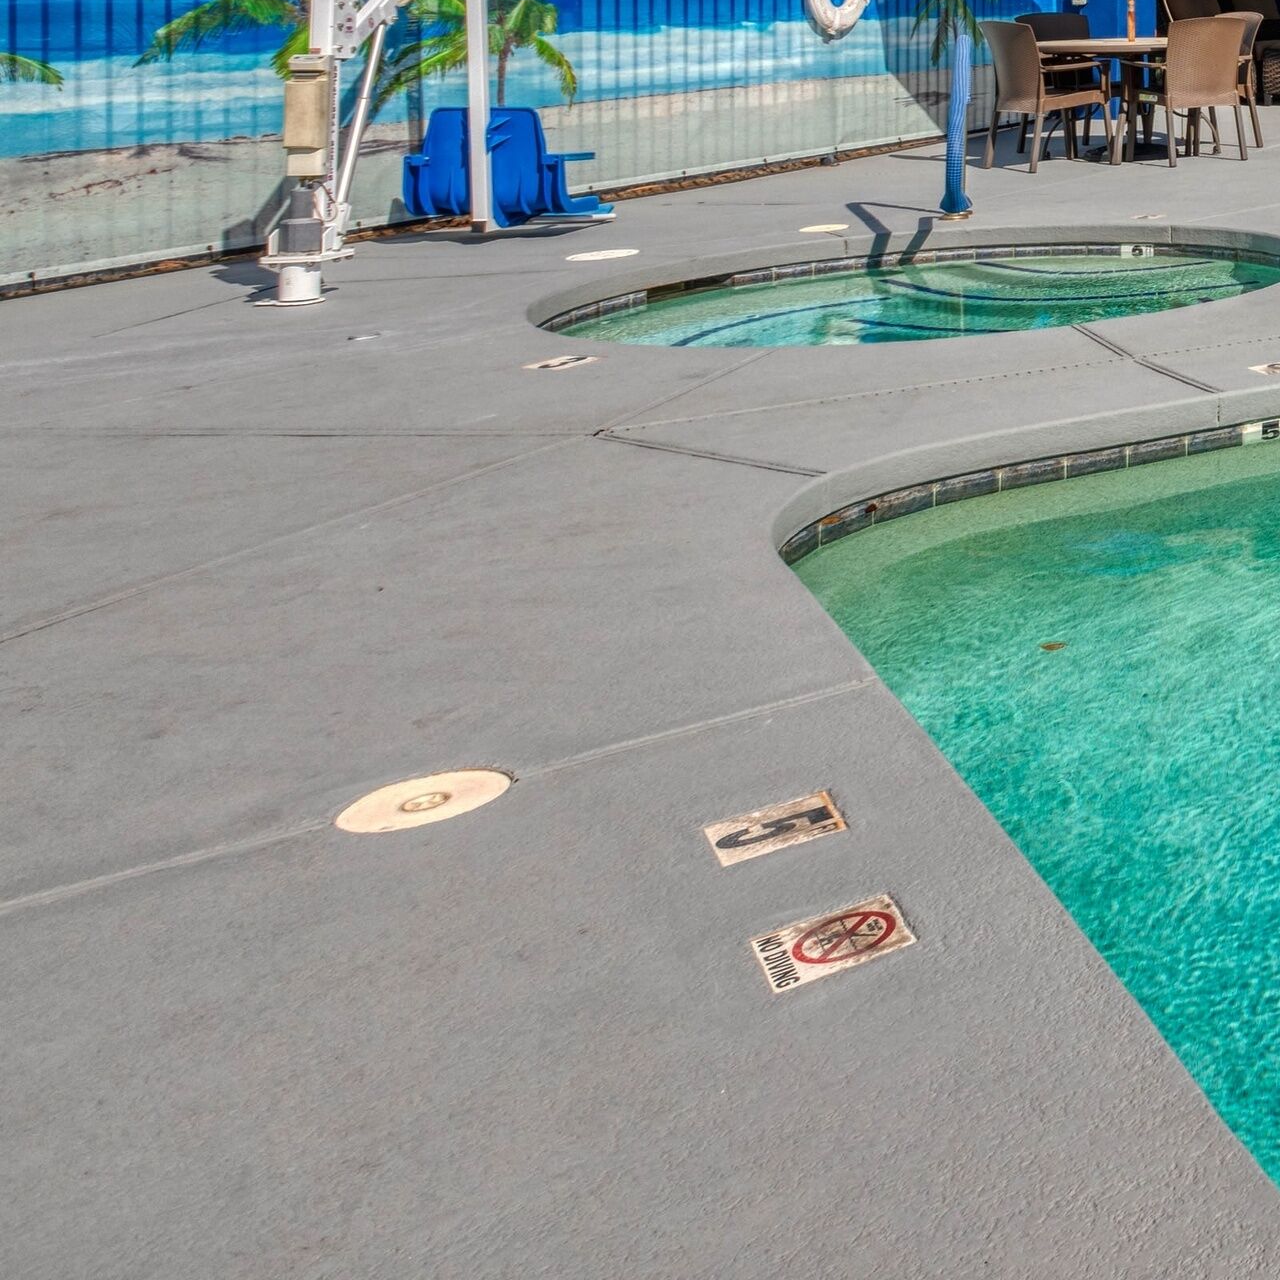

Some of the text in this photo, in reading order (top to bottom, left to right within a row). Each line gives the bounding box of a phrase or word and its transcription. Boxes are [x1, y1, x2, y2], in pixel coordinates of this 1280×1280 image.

[1261, 420, 1280, 440] 5
[715, 805, 835, 849] 5
[755, 934, 801, 989] NO DIVING
